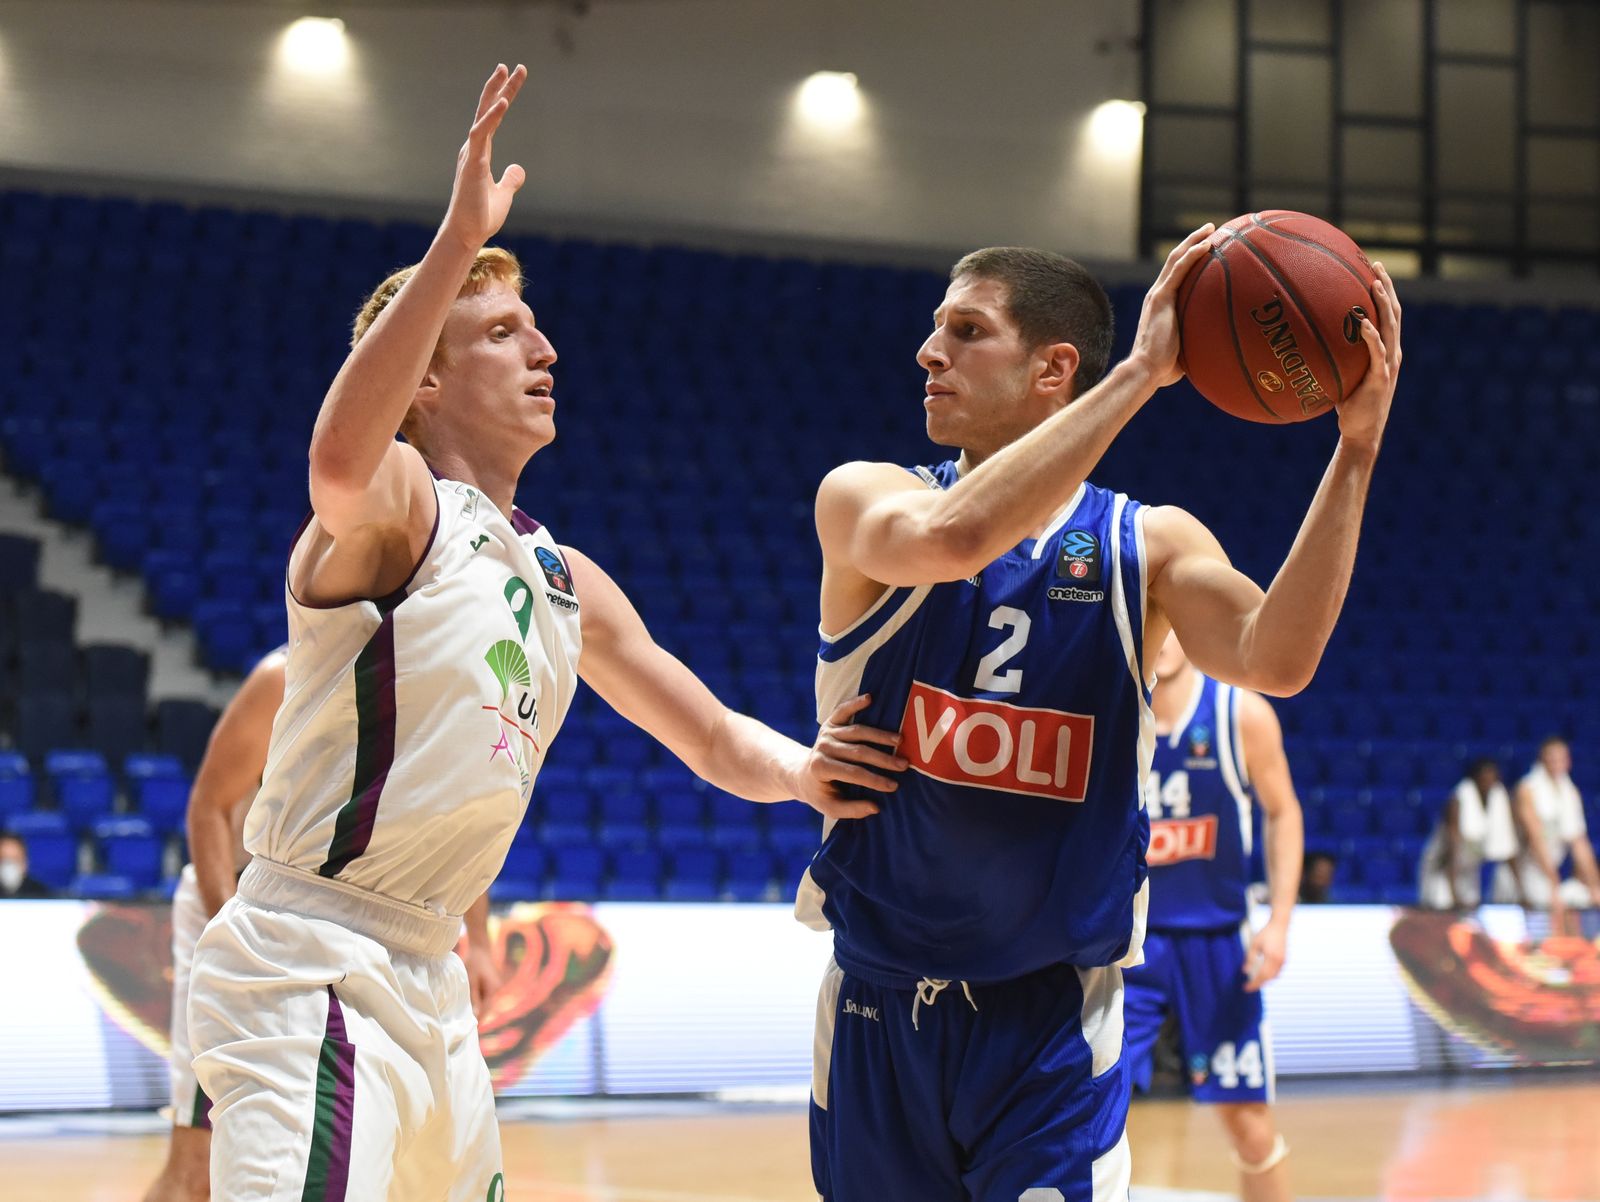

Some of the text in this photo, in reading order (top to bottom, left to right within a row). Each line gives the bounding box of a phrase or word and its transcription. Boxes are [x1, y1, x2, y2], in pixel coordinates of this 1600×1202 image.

[1250, 294, 1334, 416] PALDING
[545, 591, 579, 612] neteam
[1047, 587, 1104, 602] oneteam
[973, 605, 1032, 693] 2
[913, 695, 1072, 789] VOLI
[1149, 822, 1207, 859] OLI
[1211, 1041, 1264, 1090] 44
